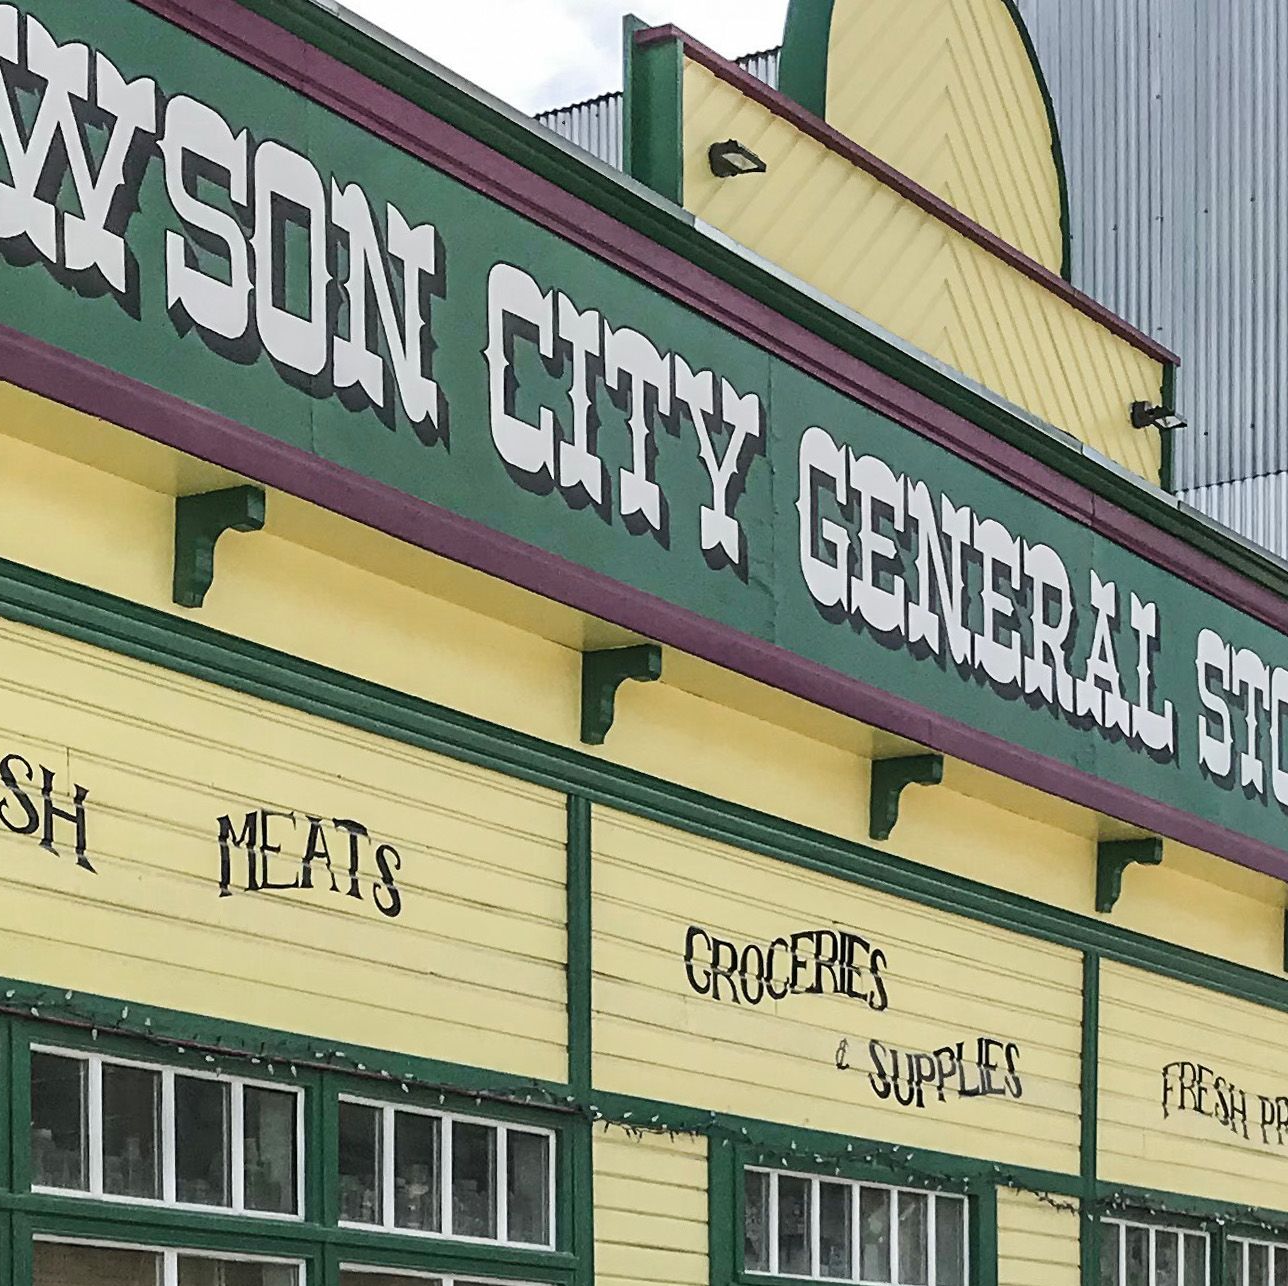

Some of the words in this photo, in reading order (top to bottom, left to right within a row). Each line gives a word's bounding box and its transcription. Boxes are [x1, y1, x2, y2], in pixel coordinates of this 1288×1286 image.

[483, 261, 762, 566] CITY
[795, 426, 1175, 753] GENERAL
[215, 808, 403, 918] MEATS
[683, 925, 889, 1012] GROCERIES
[867, 1037, 1023, 1109] SUPPLIES
[1161, 1060, 1249, 1141] FRESH
